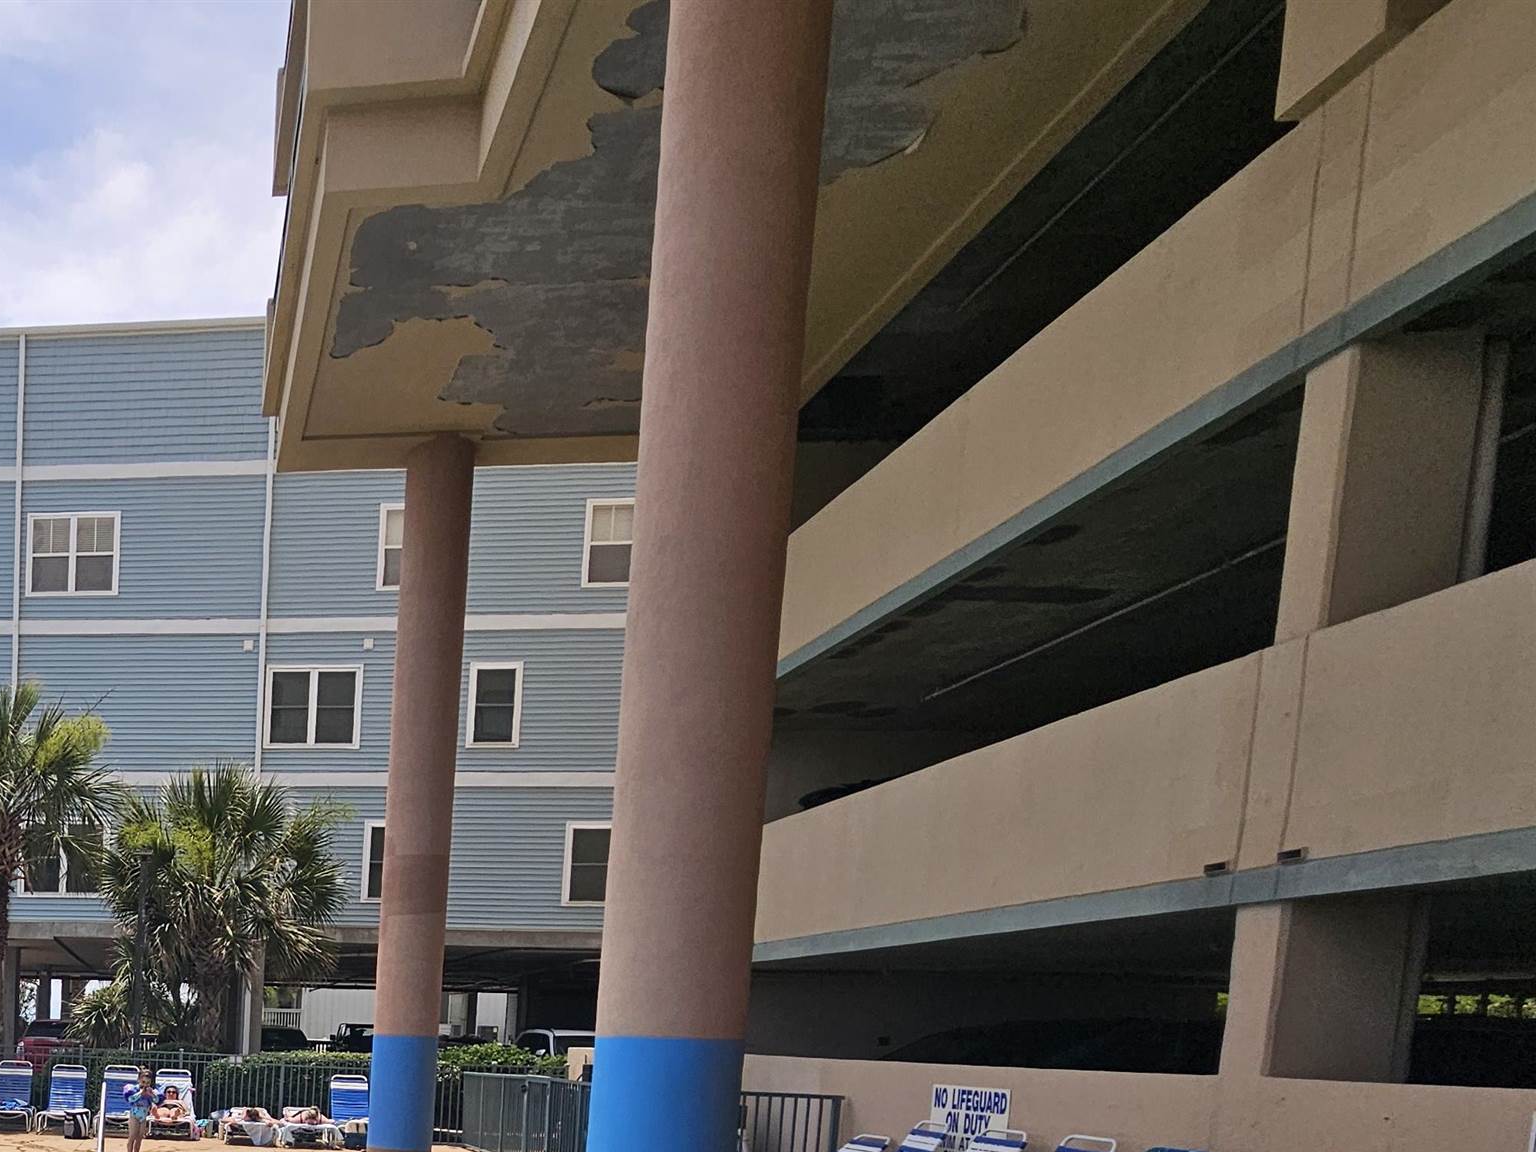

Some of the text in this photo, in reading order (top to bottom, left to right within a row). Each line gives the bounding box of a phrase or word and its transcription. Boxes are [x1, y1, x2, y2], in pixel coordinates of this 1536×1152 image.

[934, 1087, 1007, 1115] NO LIFEGUARD
[964, 1113, 991, 1136] DUTY
[959, 1137, 971, 1152] AT
